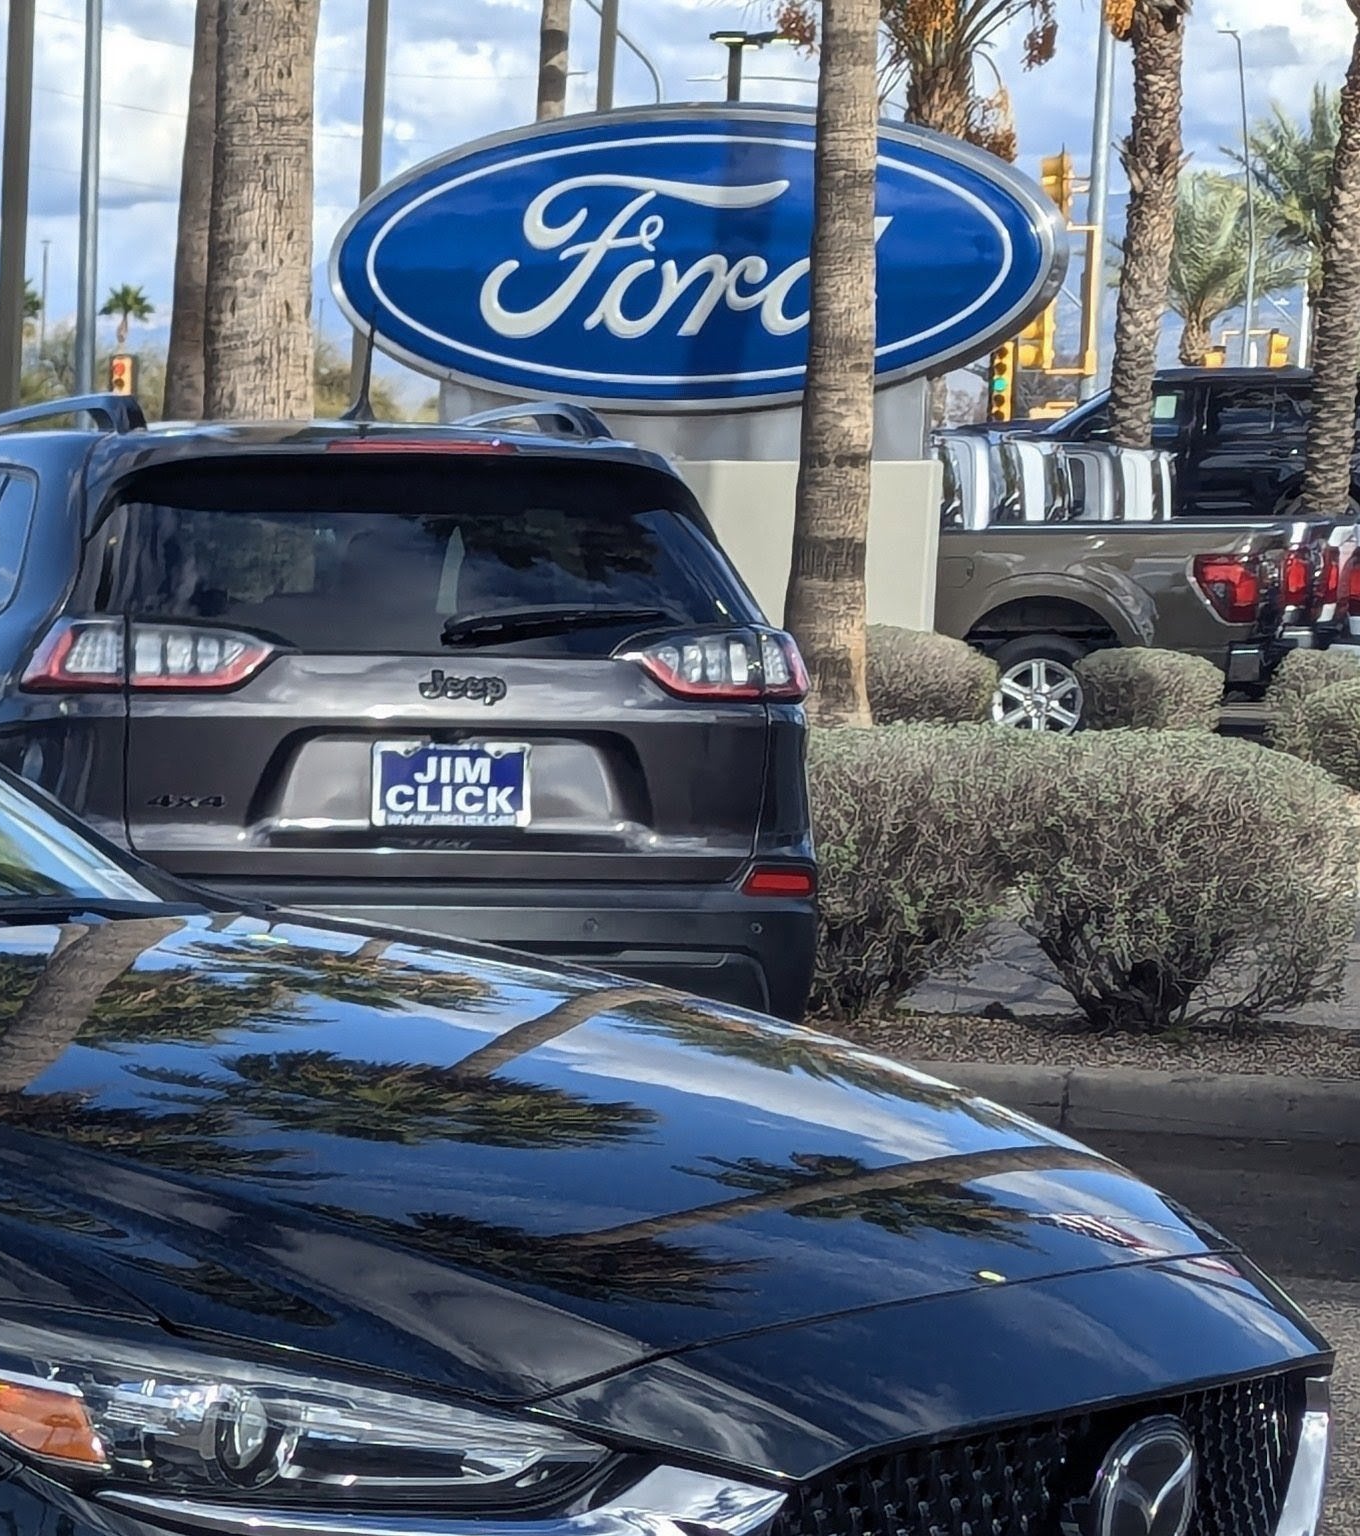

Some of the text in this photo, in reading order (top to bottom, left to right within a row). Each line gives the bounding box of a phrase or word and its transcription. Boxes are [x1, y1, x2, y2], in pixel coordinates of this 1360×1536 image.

[418, 669, 508, 707] Jeep
[413, 756, 492, 785] JIM
[385, 784, 516, 814] CLICK
